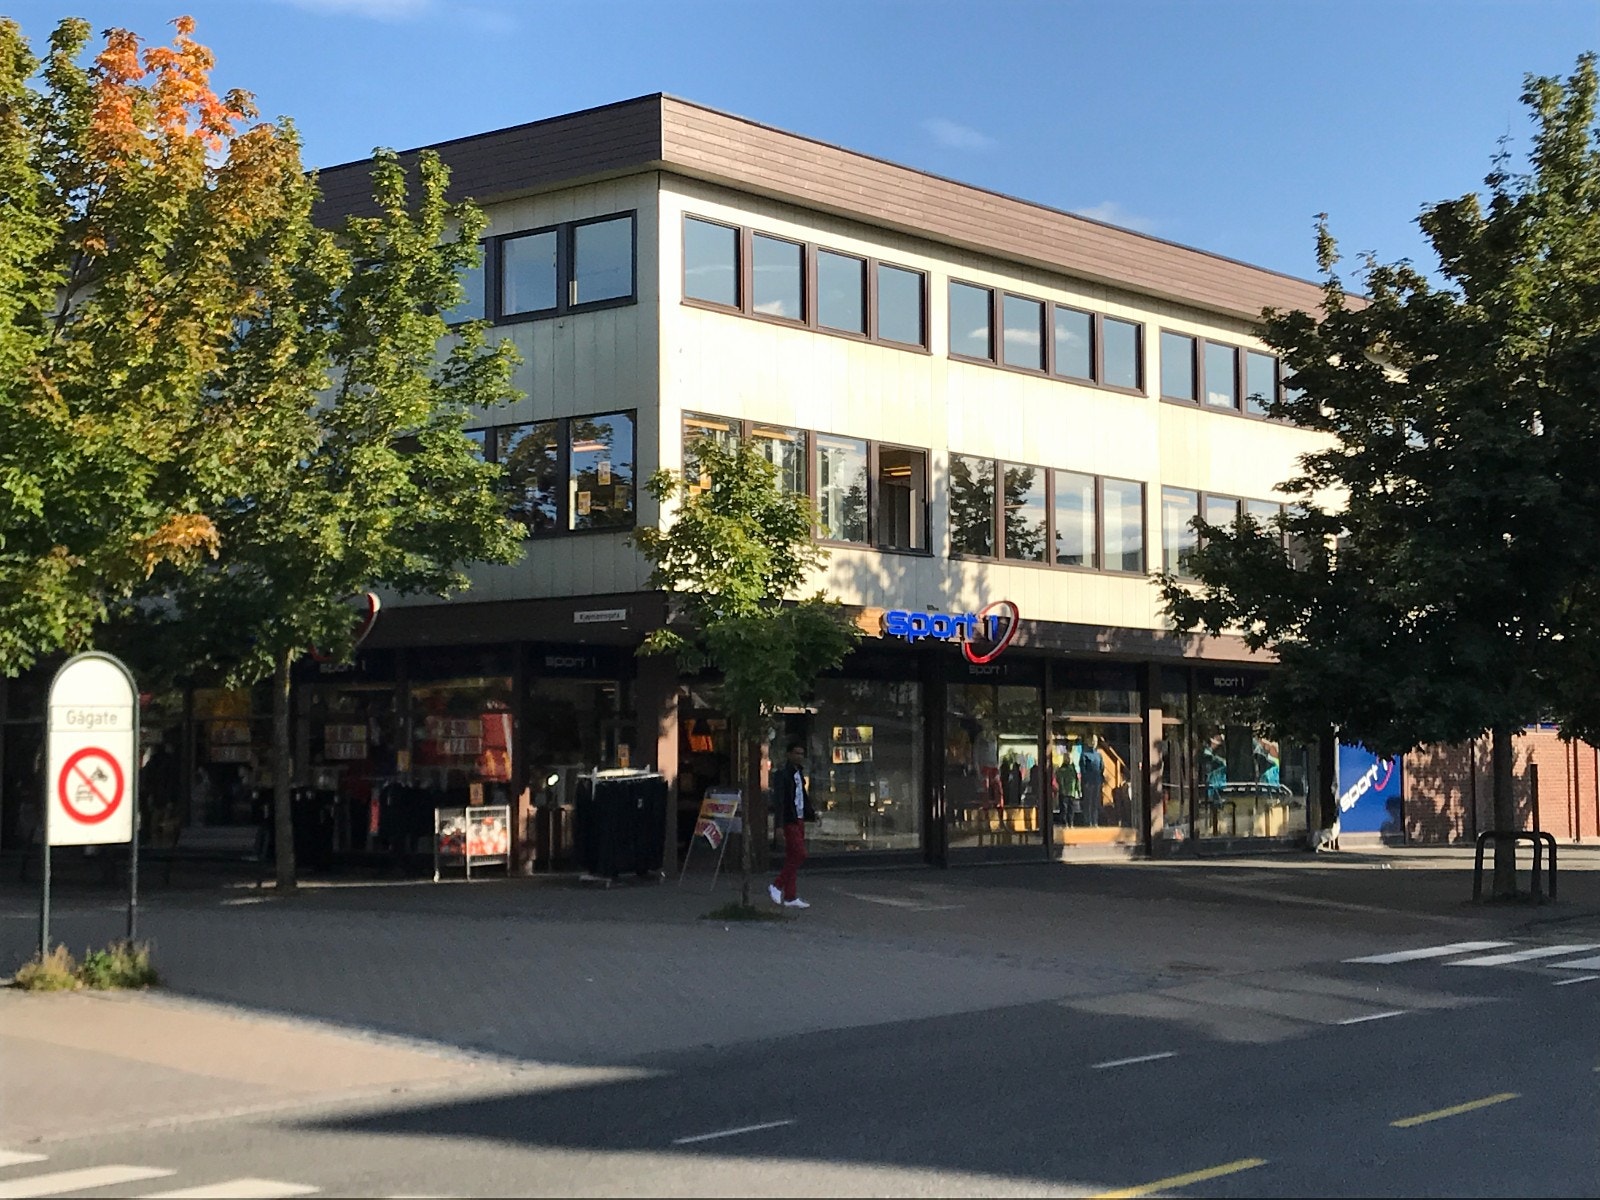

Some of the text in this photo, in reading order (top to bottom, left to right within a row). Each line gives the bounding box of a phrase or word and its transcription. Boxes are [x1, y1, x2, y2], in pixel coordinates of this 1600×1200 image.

[886, 609, 999, 645] sport 1
[969, 664, 1000, 677] sport
[66, 709, 118, 729] Gågate
[1339, 763, 1379, 813] sport
